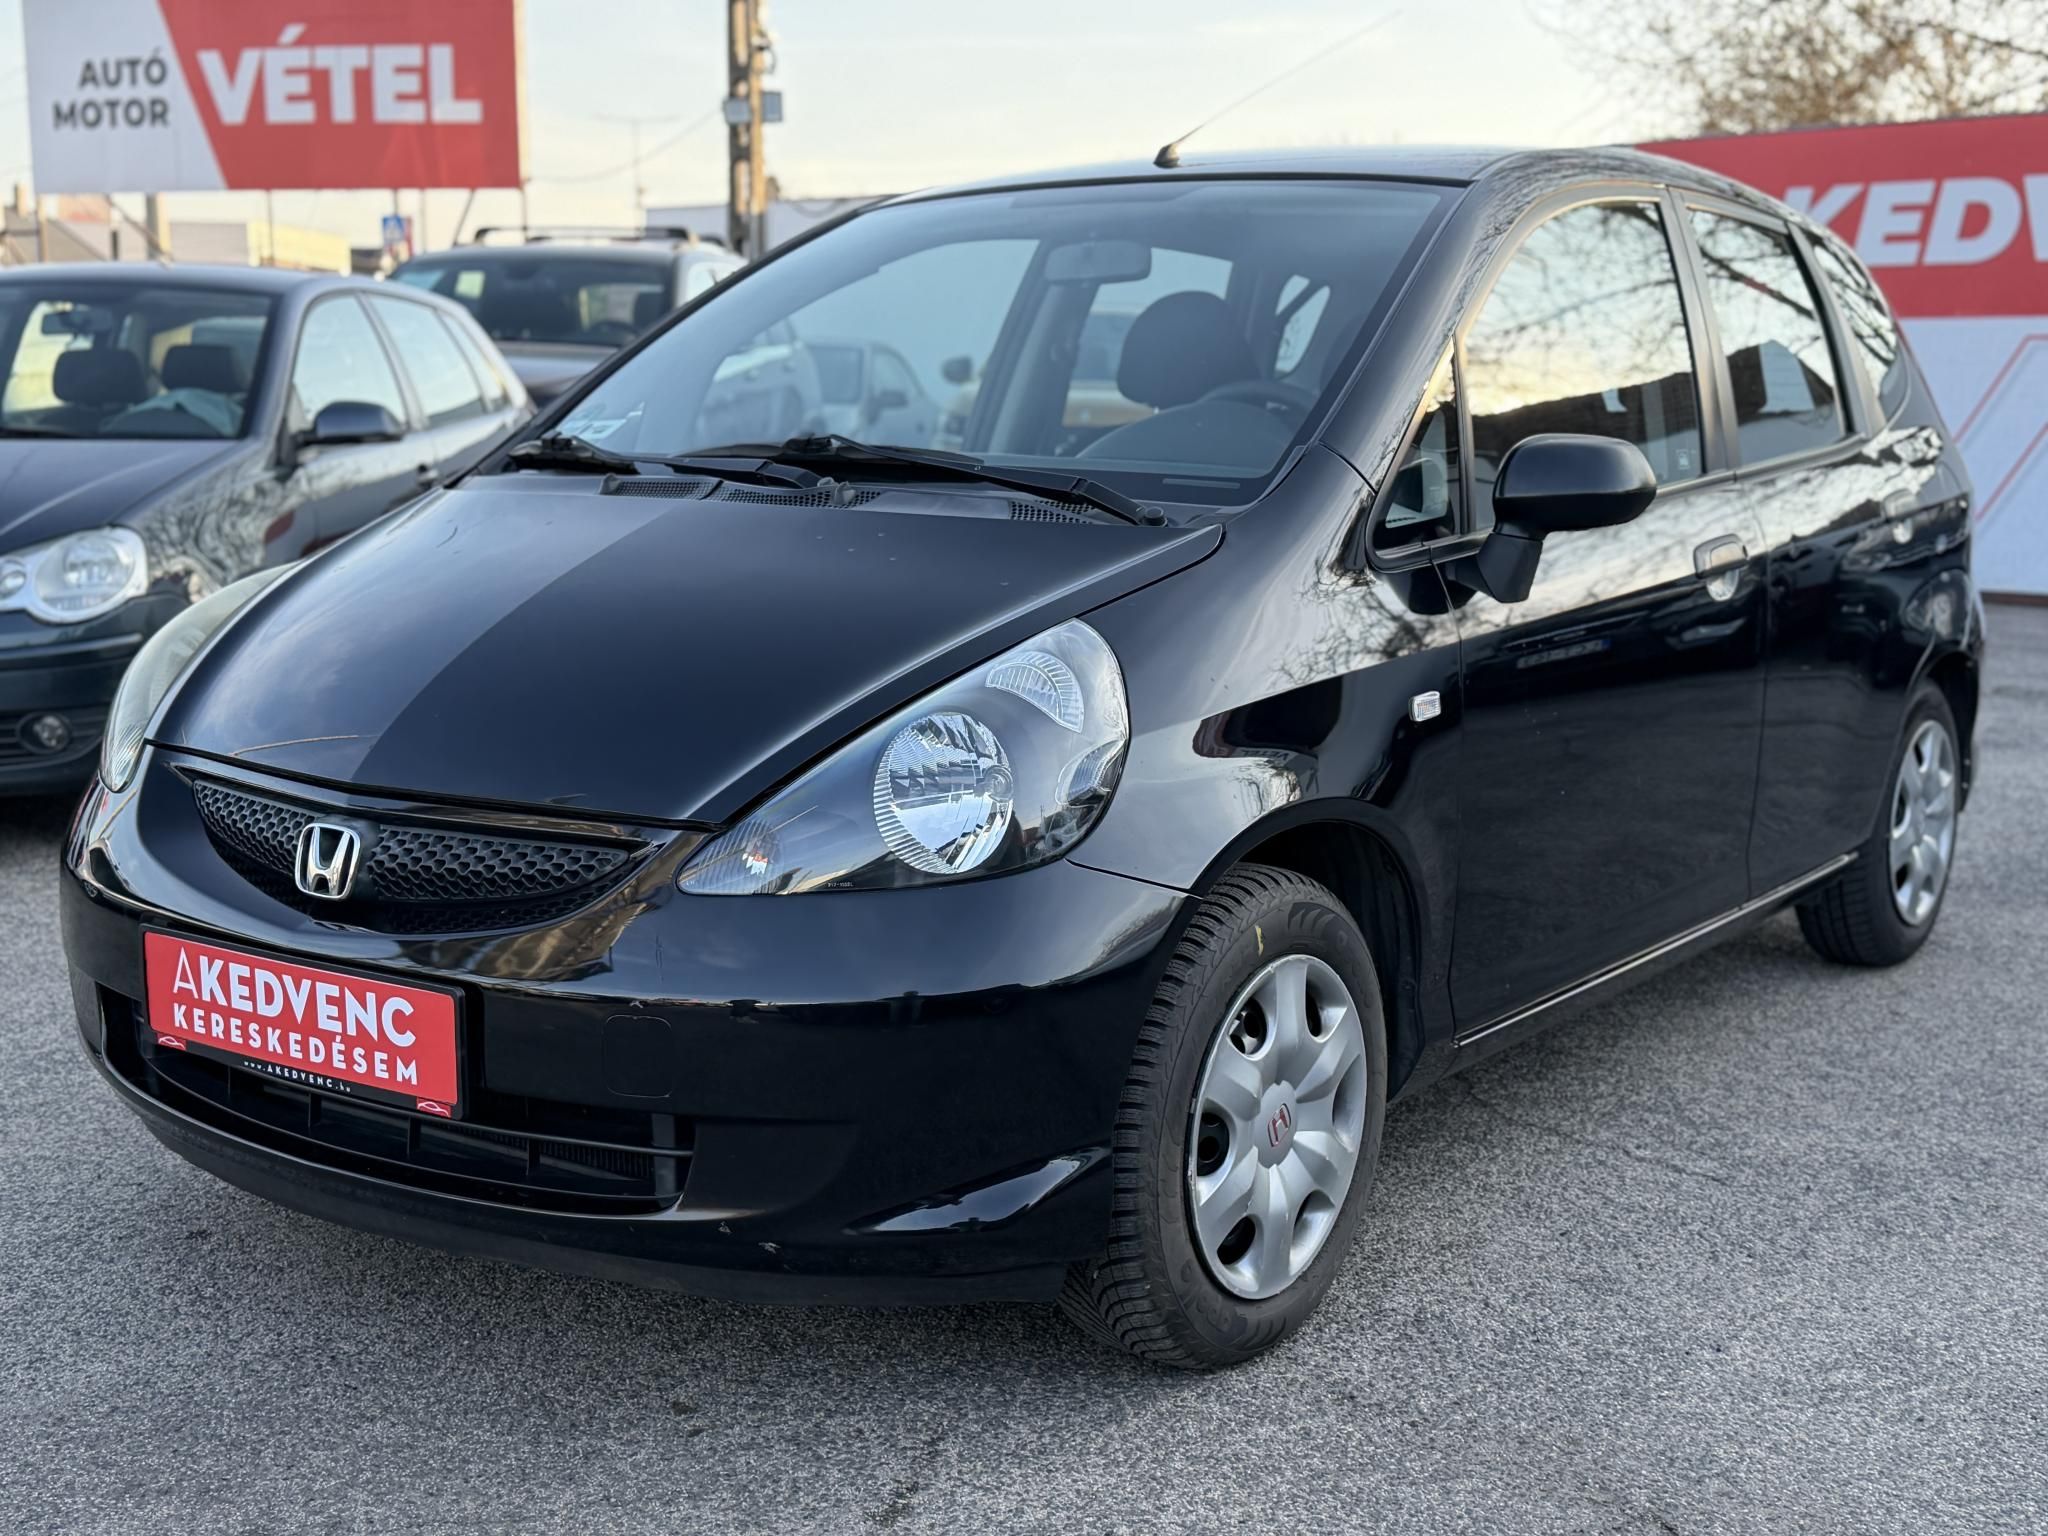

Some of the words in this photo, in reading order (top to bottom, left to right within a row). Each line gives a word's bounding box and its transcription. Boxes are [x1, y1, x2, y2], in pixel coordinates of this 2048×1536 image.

[78, 48, 168, 89] AUTÓ
[197, 24, 483, 125] VÉTEL
[52, 98, 169, 130] MOTOR
[1784, 173, 2048, 266] ED
[173, 947, 416, 1047] AKEDVENC
[173, 1003, 418, 1086] KERESKEDÉSEM
